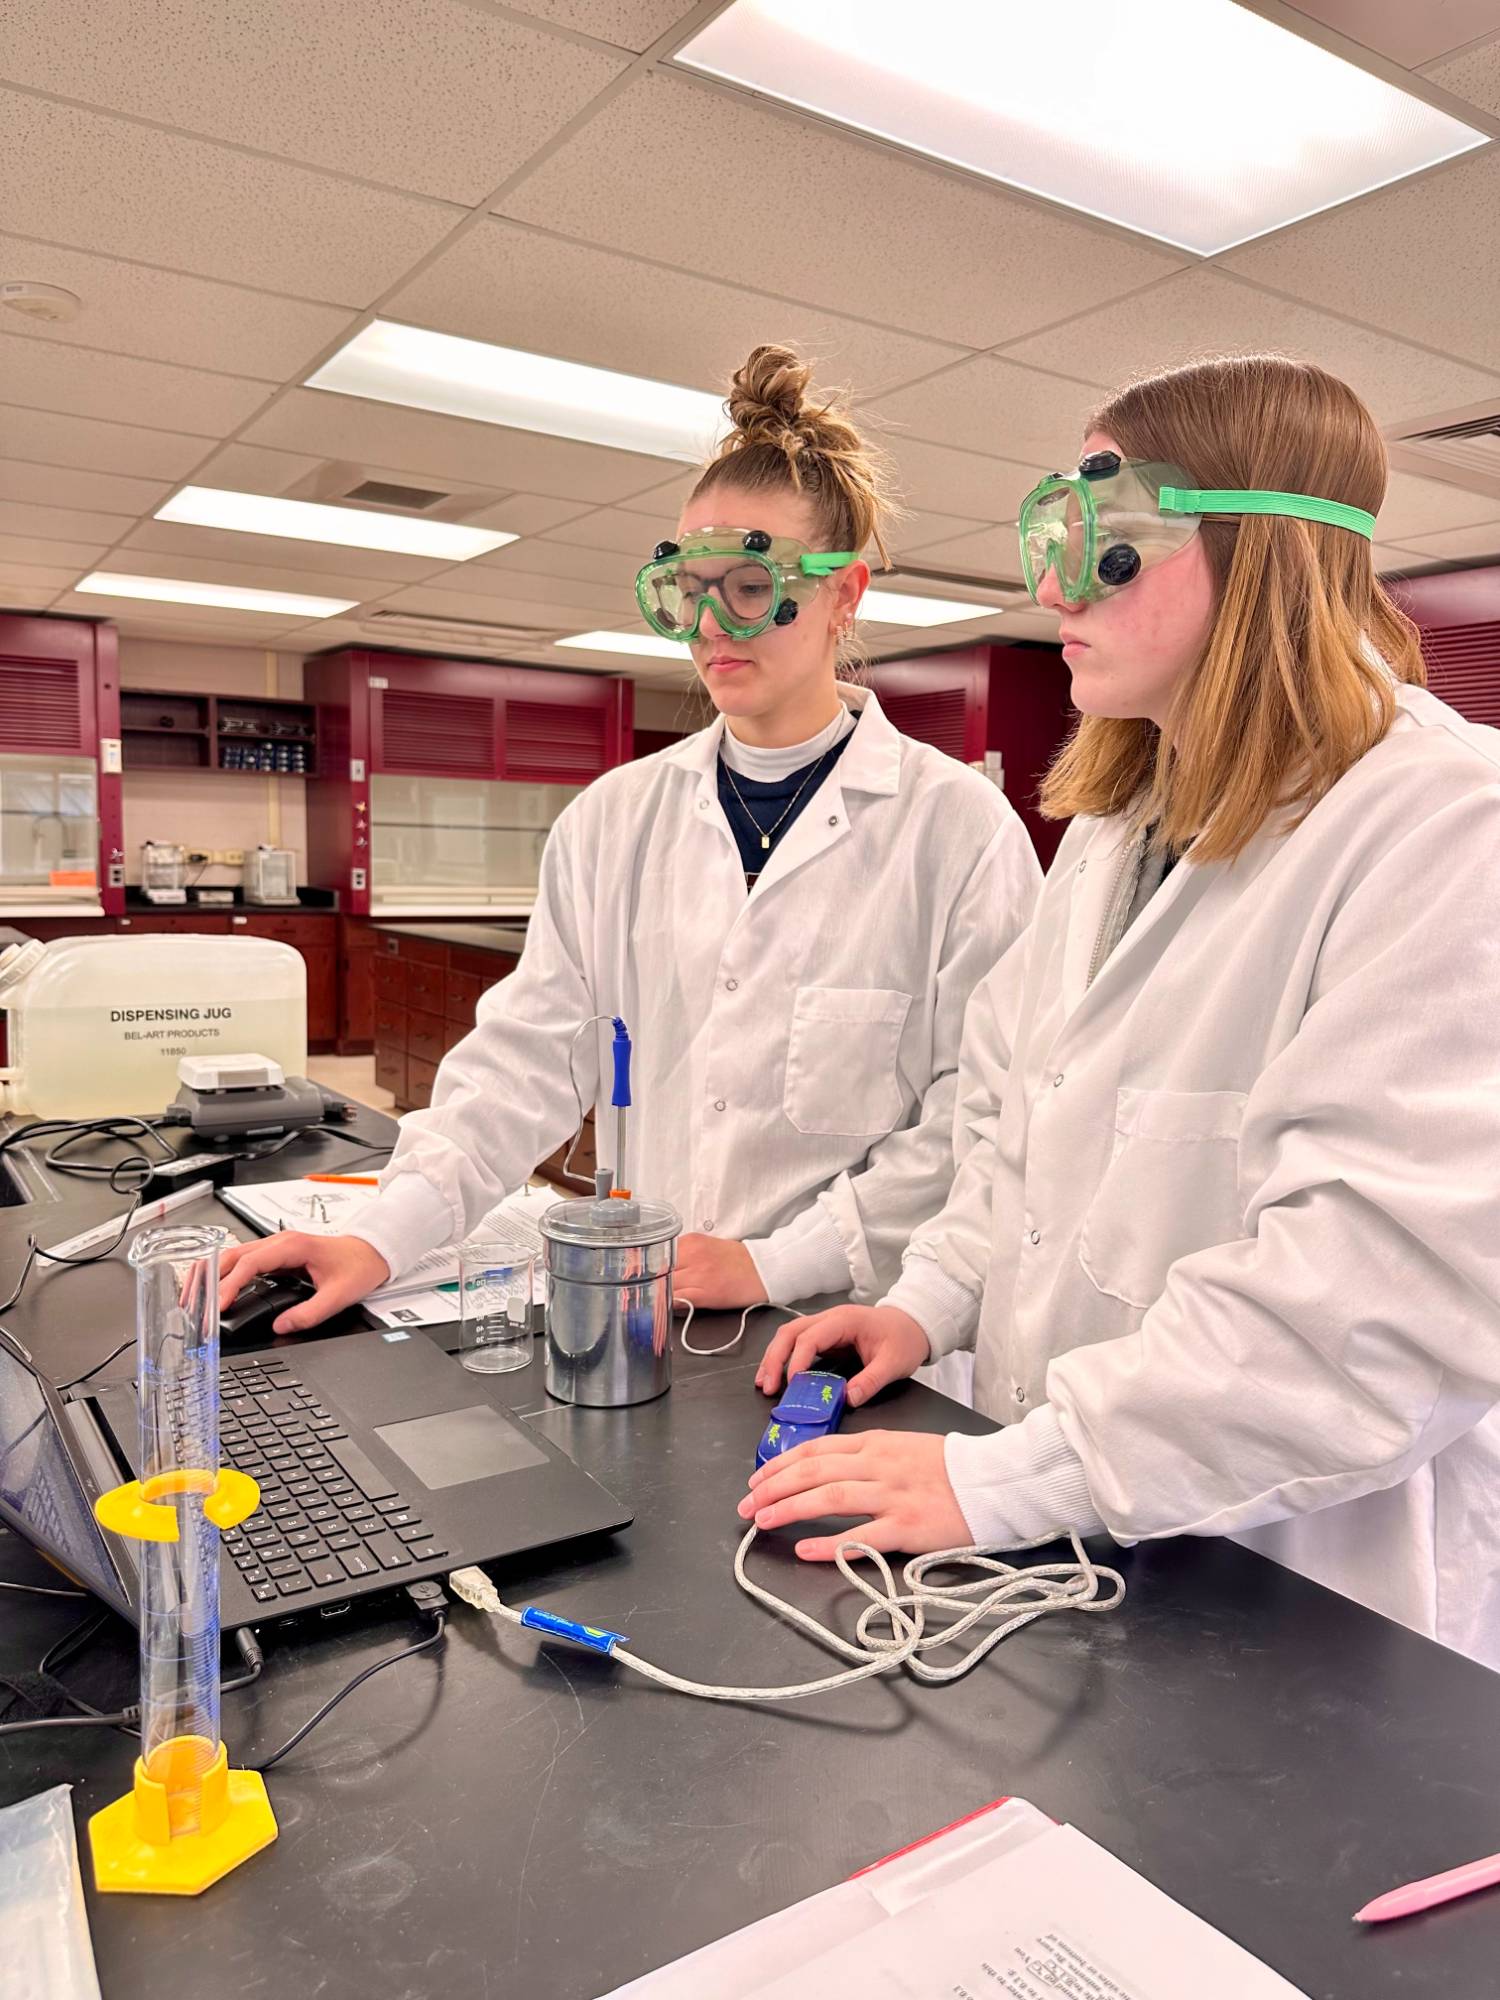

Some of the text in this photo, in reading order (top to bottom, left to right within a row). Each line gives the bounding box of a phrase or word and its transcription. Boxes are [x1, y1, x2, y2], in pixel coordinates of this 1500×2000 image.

[110, 1007, 232, 1022] DISPENSING JUG
[124, 1028, 220, 1040] BEL-ART PRODUCTS
